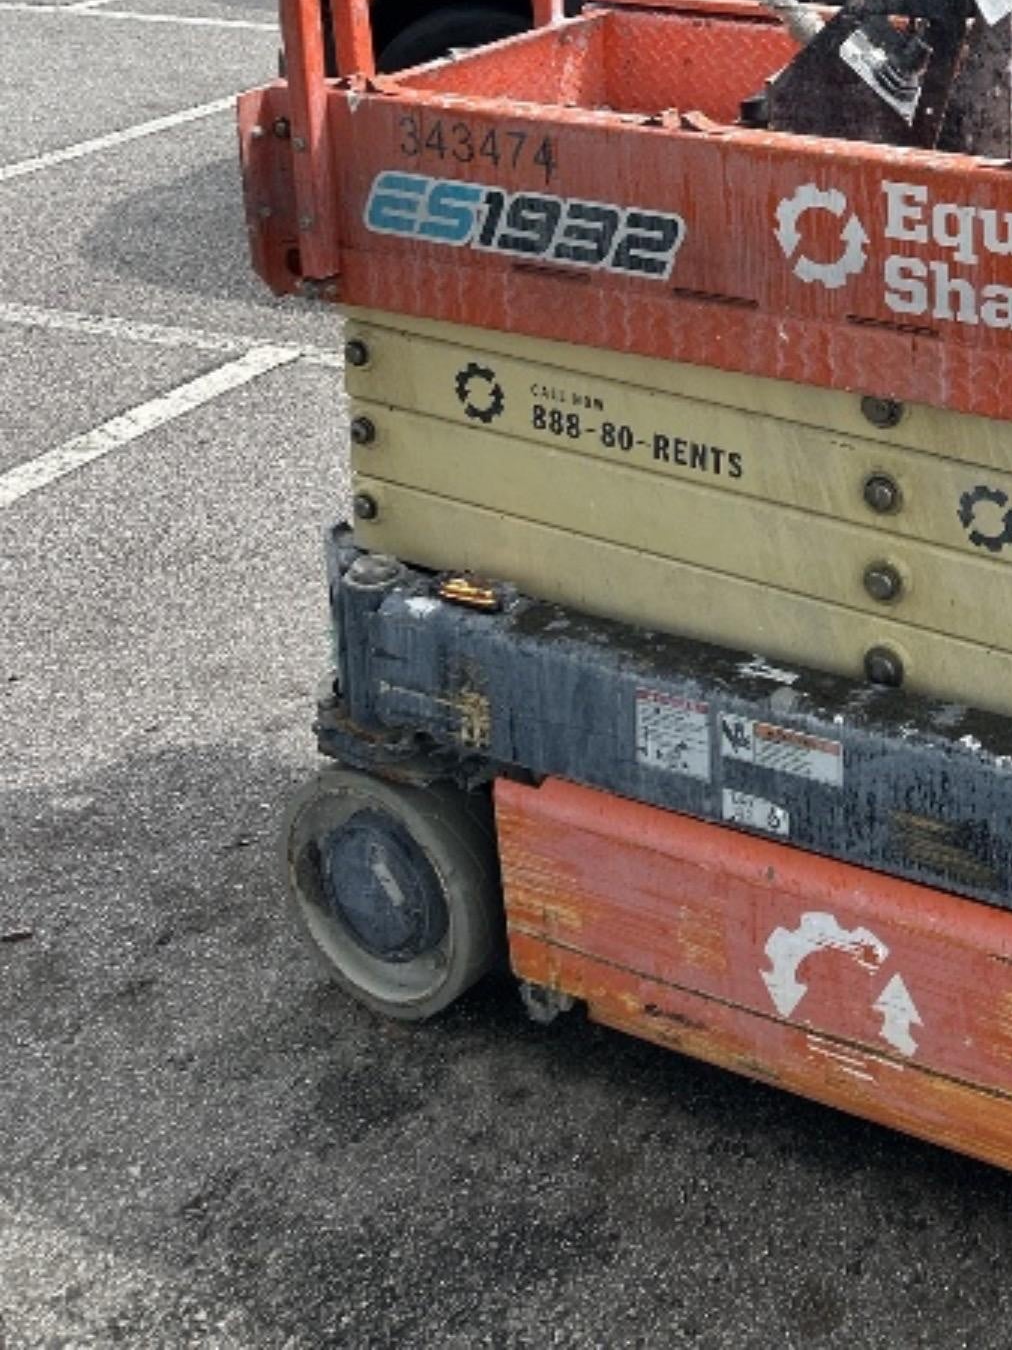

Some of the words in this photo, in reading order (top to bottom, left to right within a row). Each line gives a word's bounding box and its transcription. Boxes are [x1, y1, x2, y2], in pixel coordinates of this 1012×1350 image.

[398, 115, 557, 184] 343474
[365, 172, 684, 278] ES1932
[530, 383, 566, 403] CALL
[531, 404, 743, 478] 888-80-RENTS
